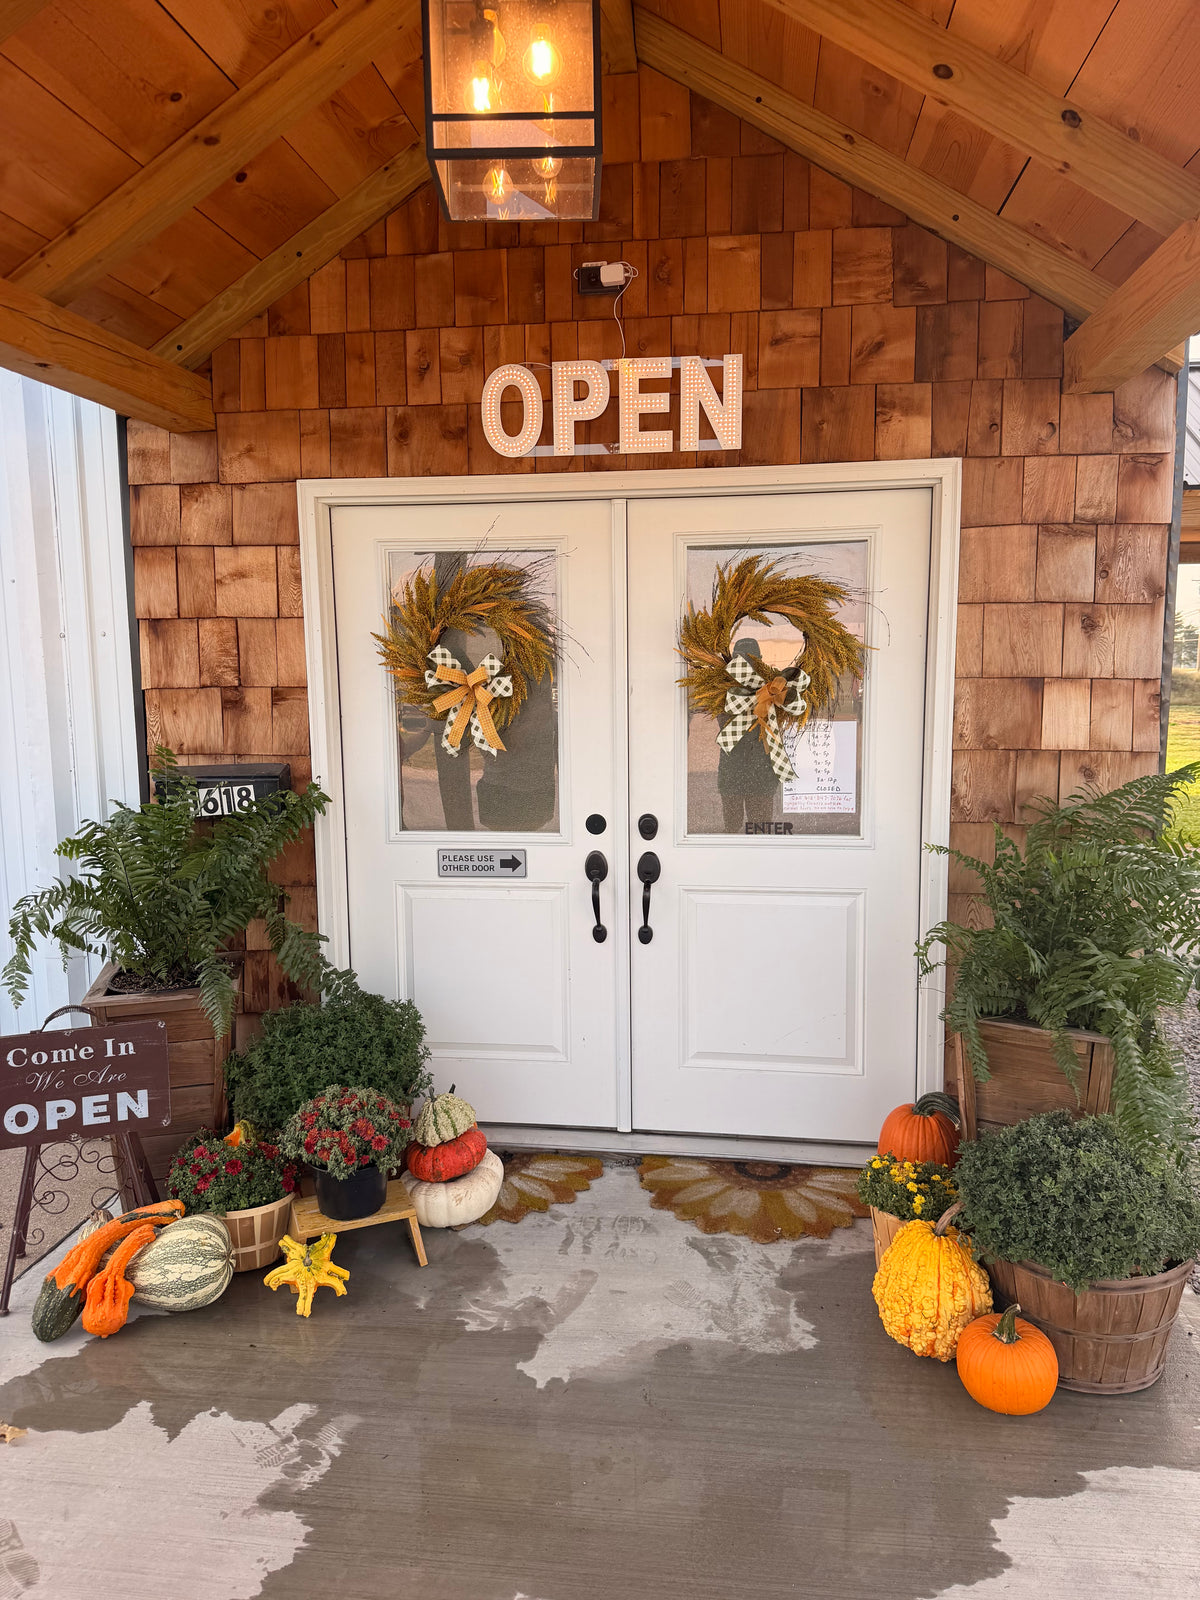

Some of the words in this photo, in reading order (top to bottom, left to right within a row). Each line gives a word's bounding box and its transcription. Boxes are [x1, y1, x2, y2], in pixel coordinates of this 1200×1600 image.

[481, 354, 743, 458] OPEN
[745, 822, 793, 835] ENTER
[442, 864, 470, 872] OTHER
[472, 864, 495, 872] DOOR
[104, 1038, 136, 1058] In
[25, 1069, 65, 1092] We
[73, 1064, 128, 1087] Are
[3, 1089, 149, 1135] OPEN
